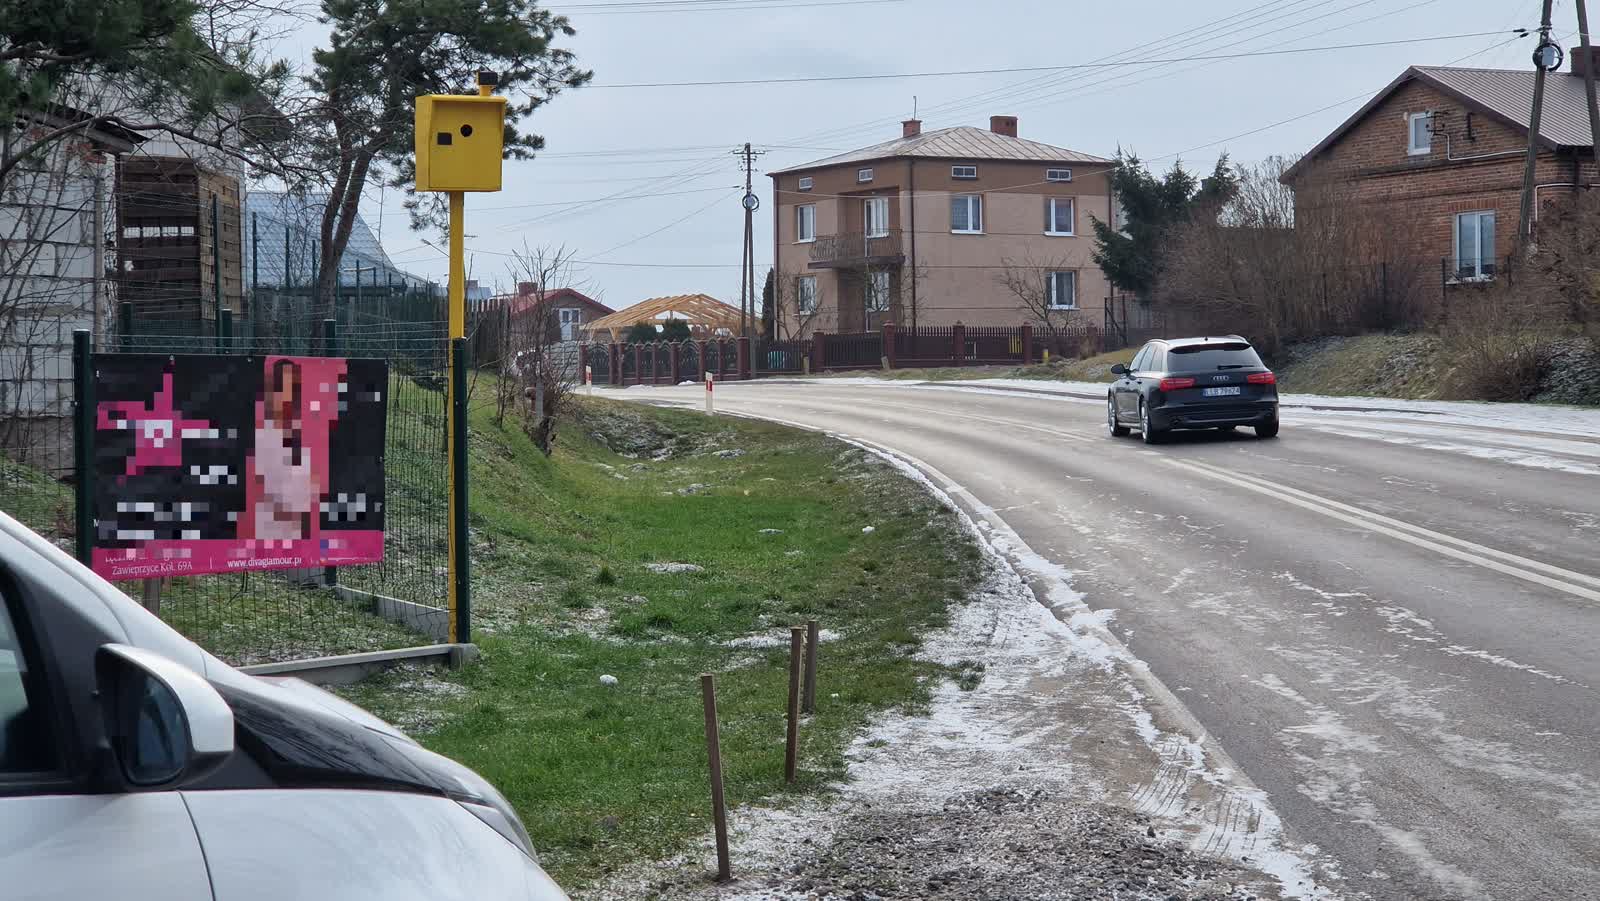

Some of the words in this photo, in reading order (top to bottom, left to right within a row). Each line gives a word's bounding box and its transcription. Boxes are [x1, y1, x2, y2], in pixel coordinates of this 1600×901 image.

[112, 564, 159, 576] Zawieprzyce
[160, 562, 175, 573] Kol.
[177, 561, 193, 571] 69A
